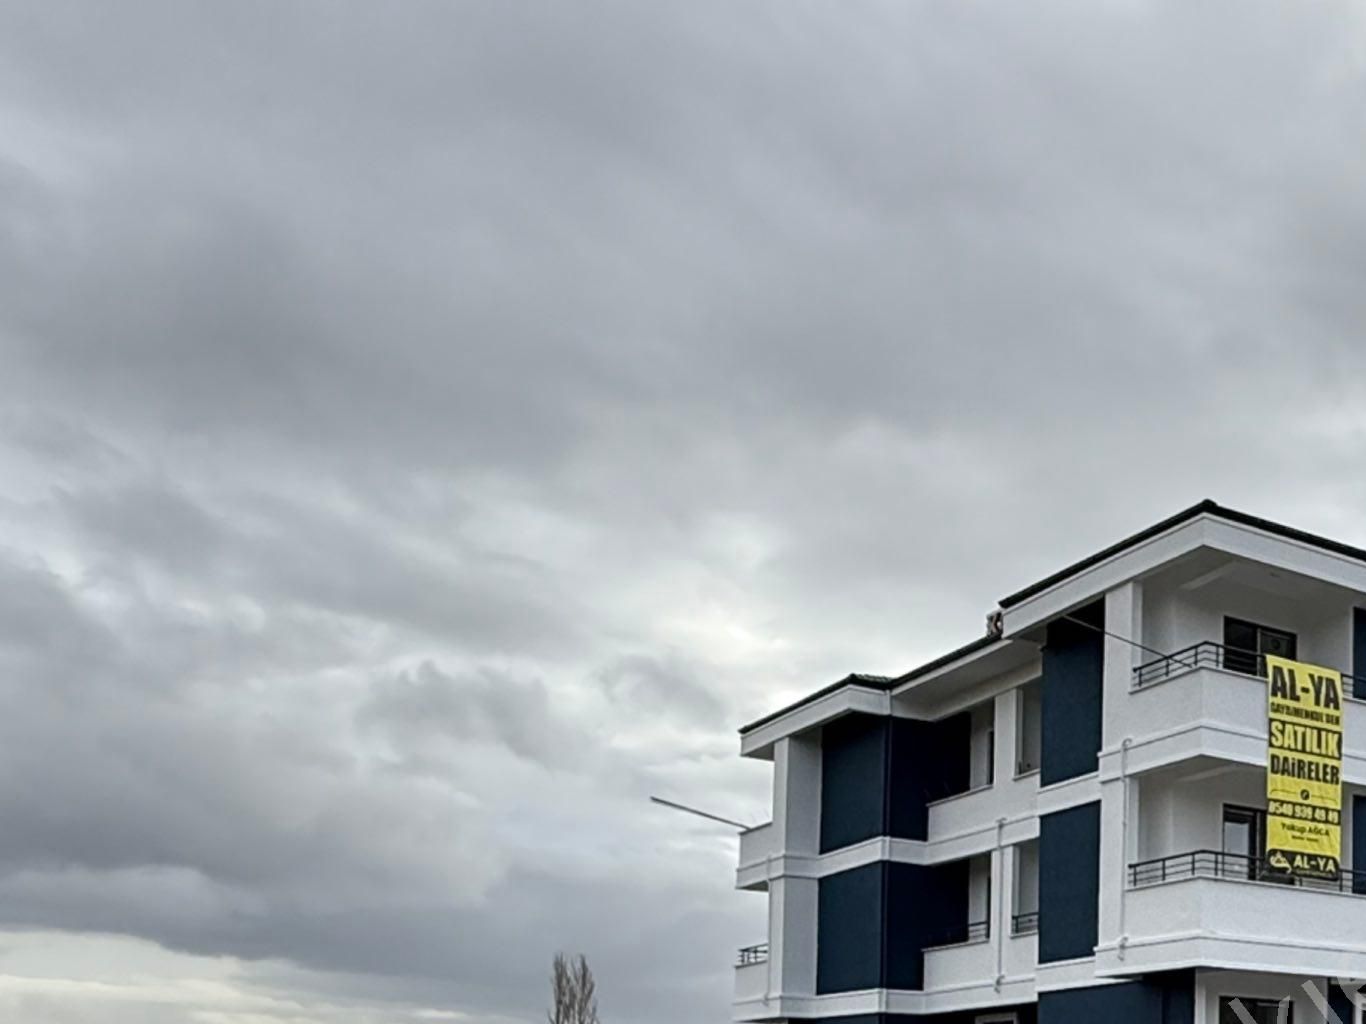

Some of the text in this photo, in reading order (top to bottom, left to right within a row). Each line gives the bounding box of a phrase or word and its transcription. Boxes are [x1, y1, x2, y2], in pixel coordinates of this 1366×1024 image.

[1271, 665, 1340, 711] AL-YA
[1271, 721, 1340, 758] SATILIK
[1271, 754, 1340, 785] DAİRELER
[1293, 854, 1337, 873] AL-YA
